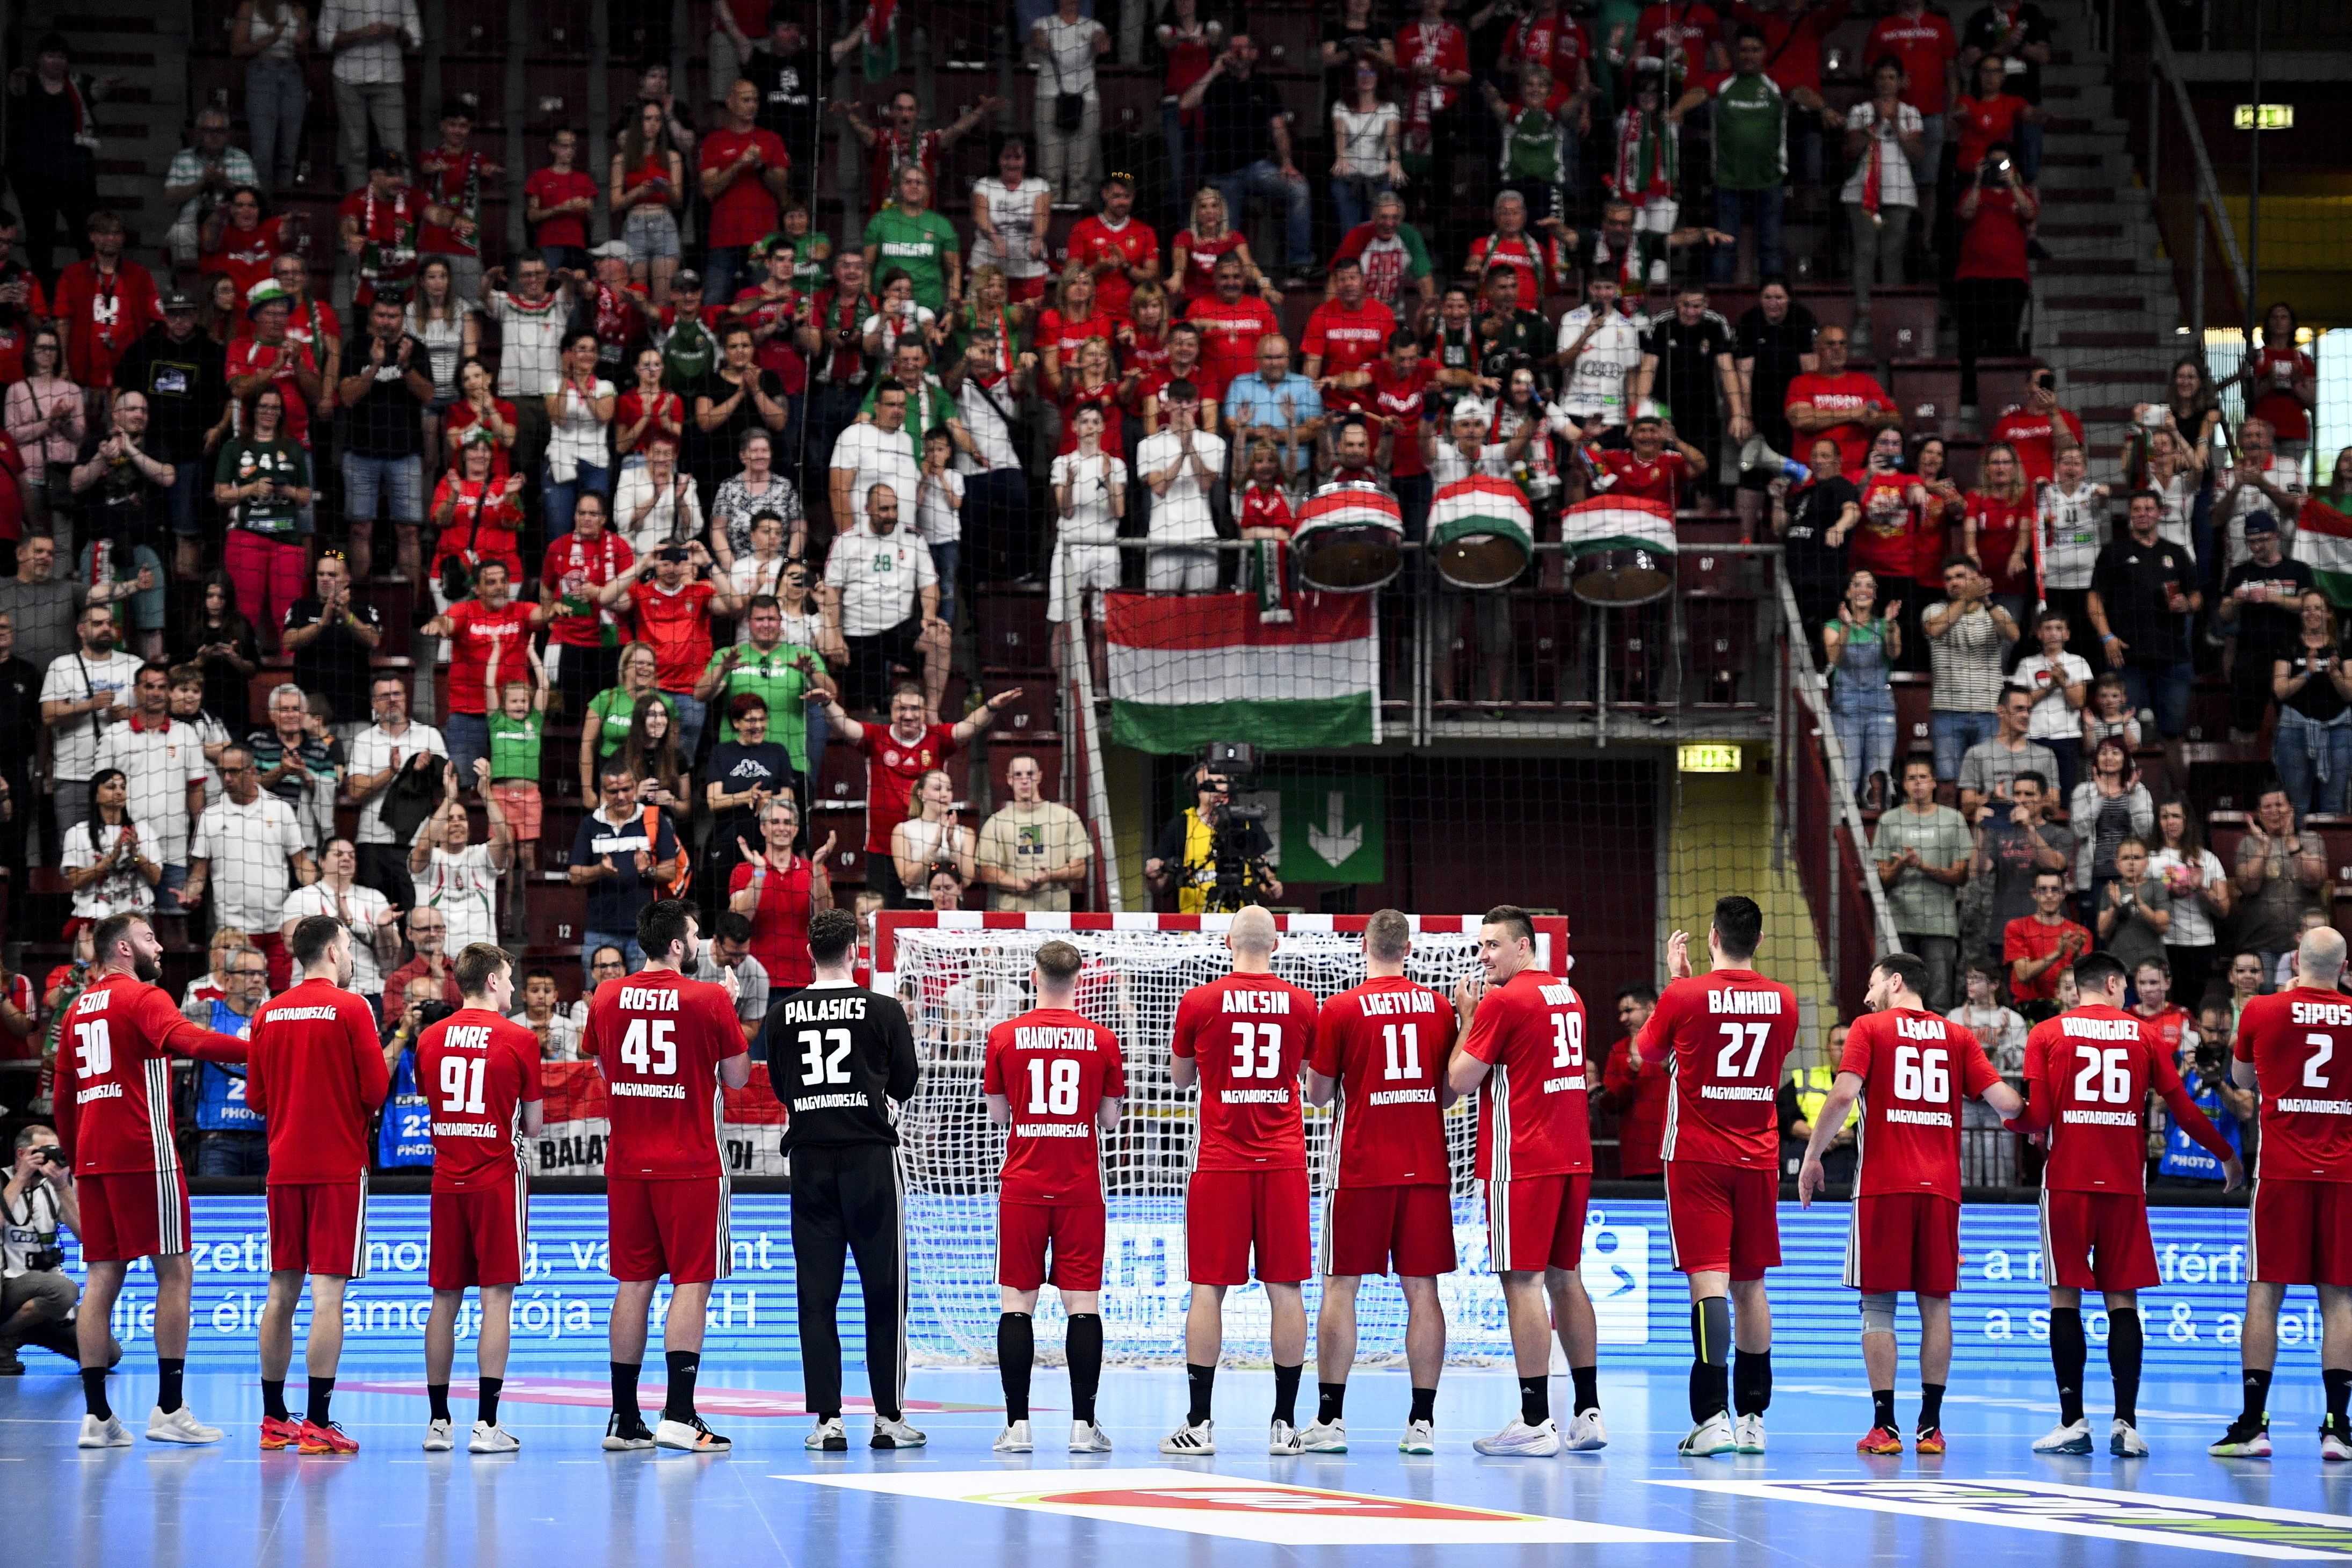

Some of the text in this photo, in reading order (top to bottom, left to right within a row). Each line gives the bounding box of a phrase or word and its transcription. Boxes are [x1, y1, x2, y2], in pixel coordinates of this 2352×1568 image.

[1227, 748, 1235, 758] 2
[841, 852, 855, 866] 09
[558, 924, 572, 939] 12
[76, 987, 112, 1015] SZITA
[619, 986, 679, 1011] ROSTA
[1222, 990, 1289, 1014] ANCSIN
[1358, 988, 1435, 1017] LIGETVÁRI
[1538, 981, 1577, 1006] BODÓ
[1708, 986, 1781, 1014] BÁNHIDI
[265, 1005, 337, 1023] MAGYARORSZÁG
[785, 997, 867, 1025] PALASICS
[2292, 1001, 2352, 1026] SIPOS
[444, 1026, 492, 1049] IMRE
[1014, 1026, 1098, 1051] KRAKOVSZKI B.
[1551, 1012, 1583, 1069] 39
[1896, 1016, 1947, 1041] LÉKAI
[2060, 1017, 2140, 1041] RODRIGUEZ
[74, 1019, 112, 1079] 30
[621, 1019, 677, 1075] 45
[797, 1028, 851, 1086] 32
[1231, 1022, 1282, 1079] 33
[1382, 1023, 1422, 1080] 11
[1717, 1022, 1772, 1077] 27
[2303, 1033, 2333, 1088] 2
[440, 1056, 486, 1114] 91
[1027, 1058, 1080, 1115] 18
[1894, 1046, 1949, 1103] 66
[2075, 1045, 2130, 1104] 26
[227, 1078, 246, 1100] 2
[612, 1082, 685, 1099] MAGYARORSZÁG
[793, 1091, 868, 1112] MAGYARORSZÁG
[1221, 1087, 1289, 1104] MAGYARORSZÁG
[1370, 1086, 1436, 1106] MAGYARORSZÁ
[432, 1122, 497, 1138] MAGYARORSZÁG
[1016, 1122, 1089, 1137] MAGYARORSZÁG
[2063, 1110, 2137, 1126] MAGYARORSZÁG
[397, 1143, 436, 1158] PHOT
[2169, 1153, 2216, 1170] PHOTO
[2161, 1242, 2246, 1283] férf
[2167, 1301, 2201, 1342] &
